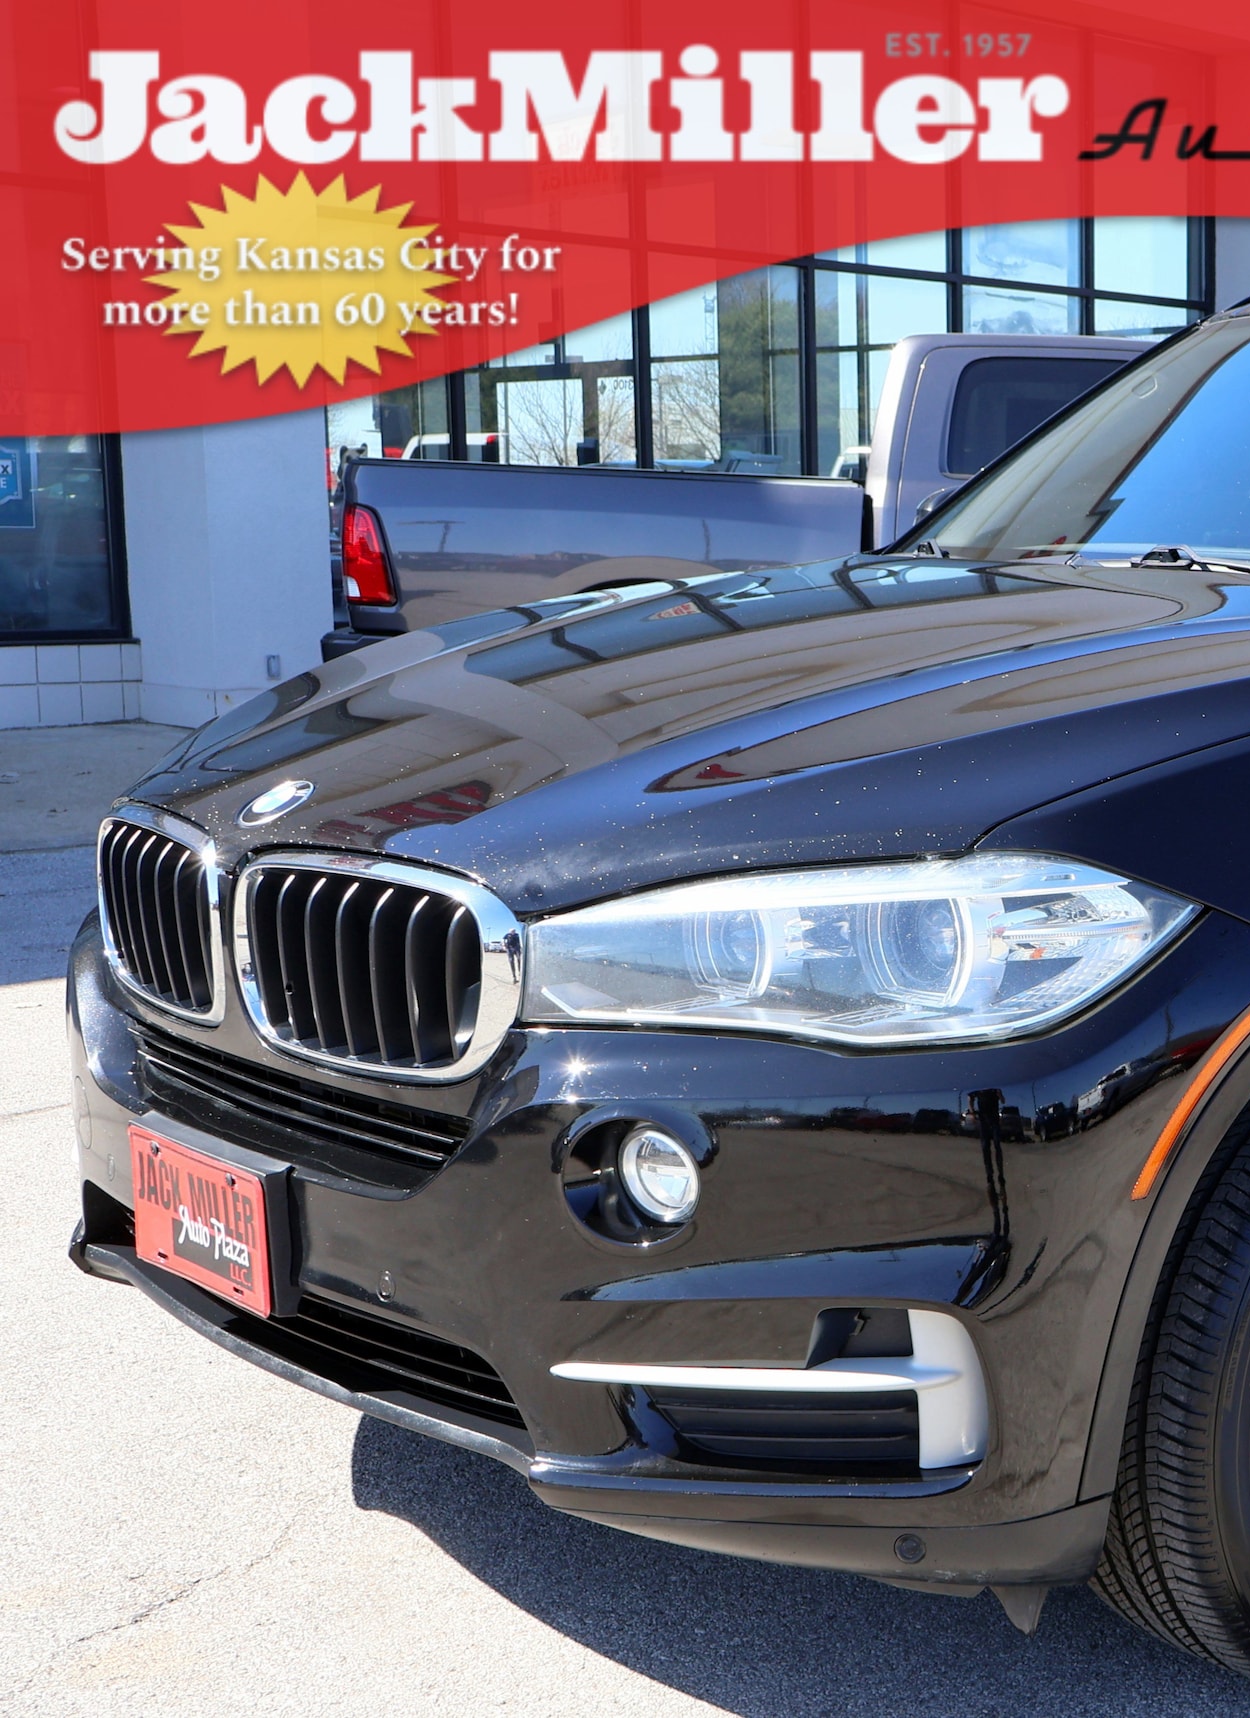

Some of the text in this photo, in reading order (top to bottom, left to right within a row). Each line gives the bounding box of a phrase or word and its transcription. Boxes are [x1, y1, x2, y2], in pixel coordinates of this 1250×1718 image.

[138, 1151, 256, 1249] JACK MILLER
[178, 1204, 250, 1268] Auto Plaza
